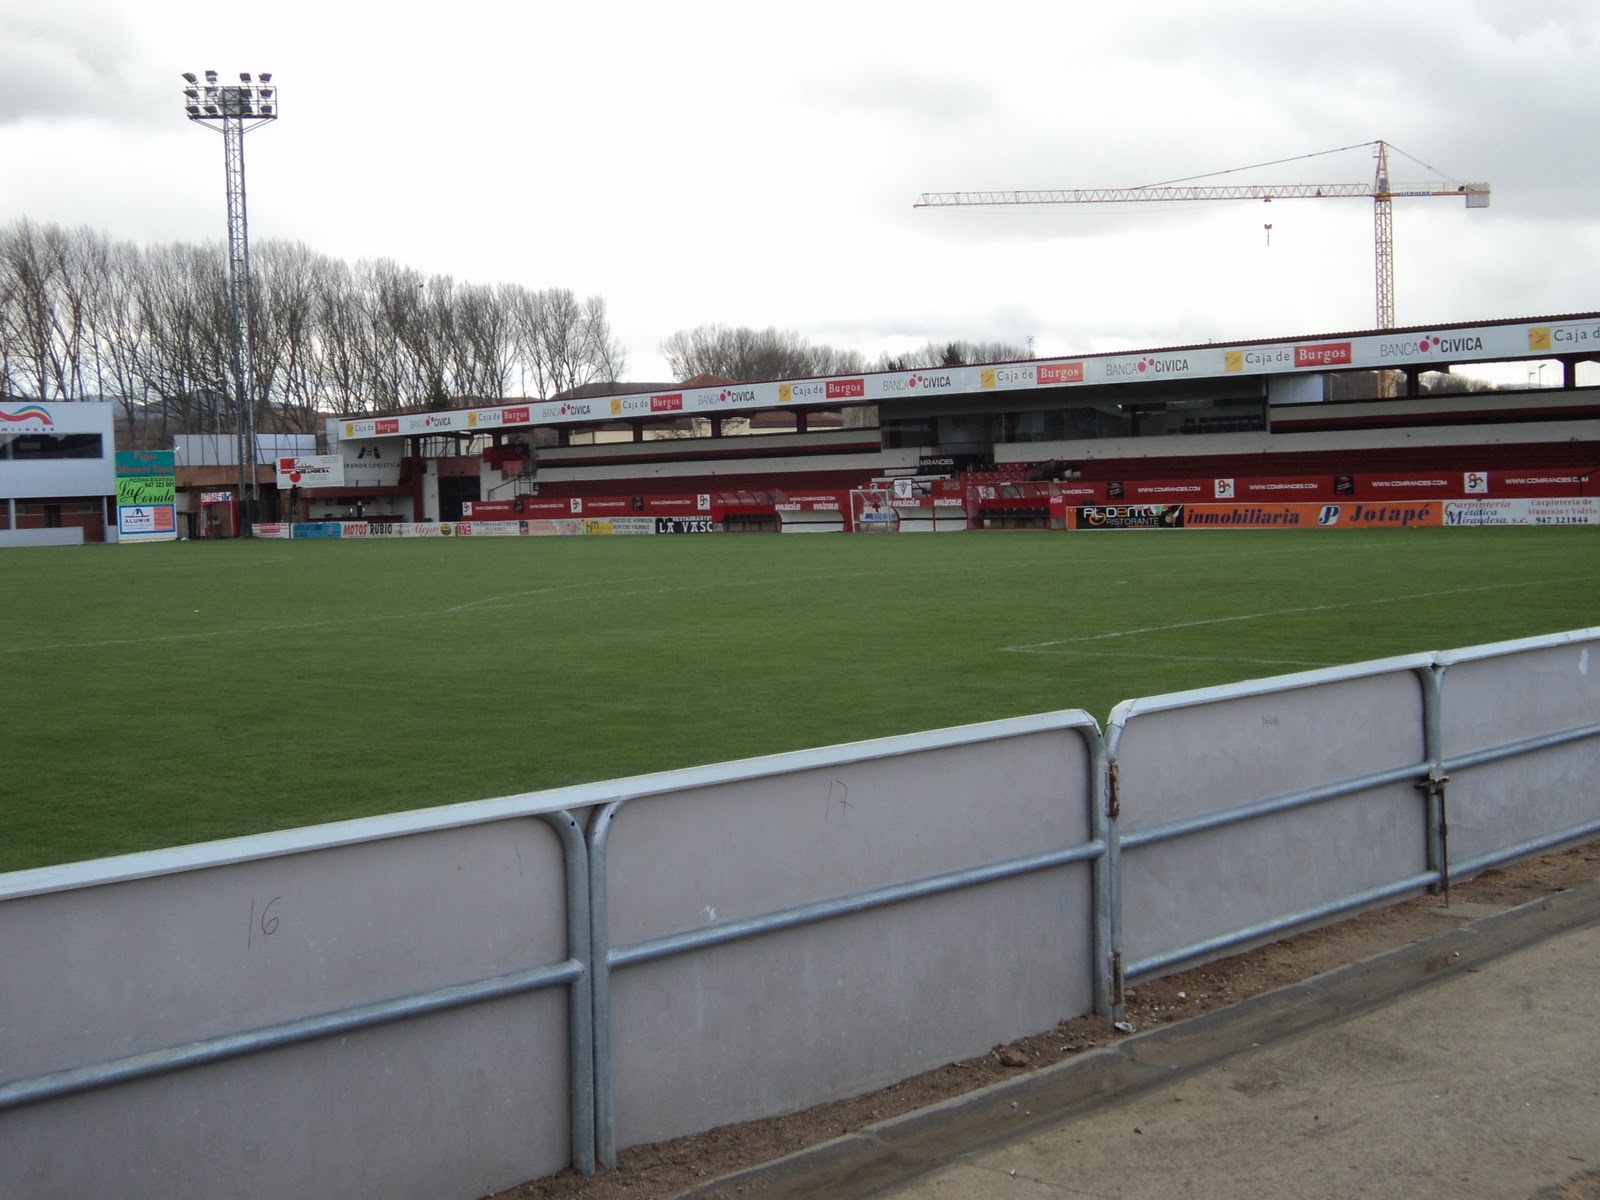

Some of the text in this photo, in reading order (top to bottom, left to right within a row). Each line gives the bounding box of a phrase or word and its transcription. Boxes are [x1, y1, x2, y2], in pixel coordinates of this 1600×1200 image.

[1554, 326, 1600, 343] Caja d
[1380, 342, 1420, 357] BANCA
[1245, 348, 1346, 365] Caja de Burgos
[997, 367, 1079, 382] Caja de Burgos
[1106, 363, 1138, 376] BANCA
[792, 383, 861, 396] Caja de Burgos
[883, 379, 909, 391] BANCA
[622, 397, 681, 410] Caja de Burgos
[698, 394, 720, 405] BANCA
[477, 410, 528, 421] Caja de Burgos
[1187, 508, 1300, 524] inmobiliaria
[1349, 504, 1430, 525] Jotapé
[1555, 516, 1589, 524] 321844
[343, 524, 368, 535] MOTOS
[370, 523, 392, 535] RUBIO
[659, 522, 675, 533] LA
[248, 896, 281, 951] 16
